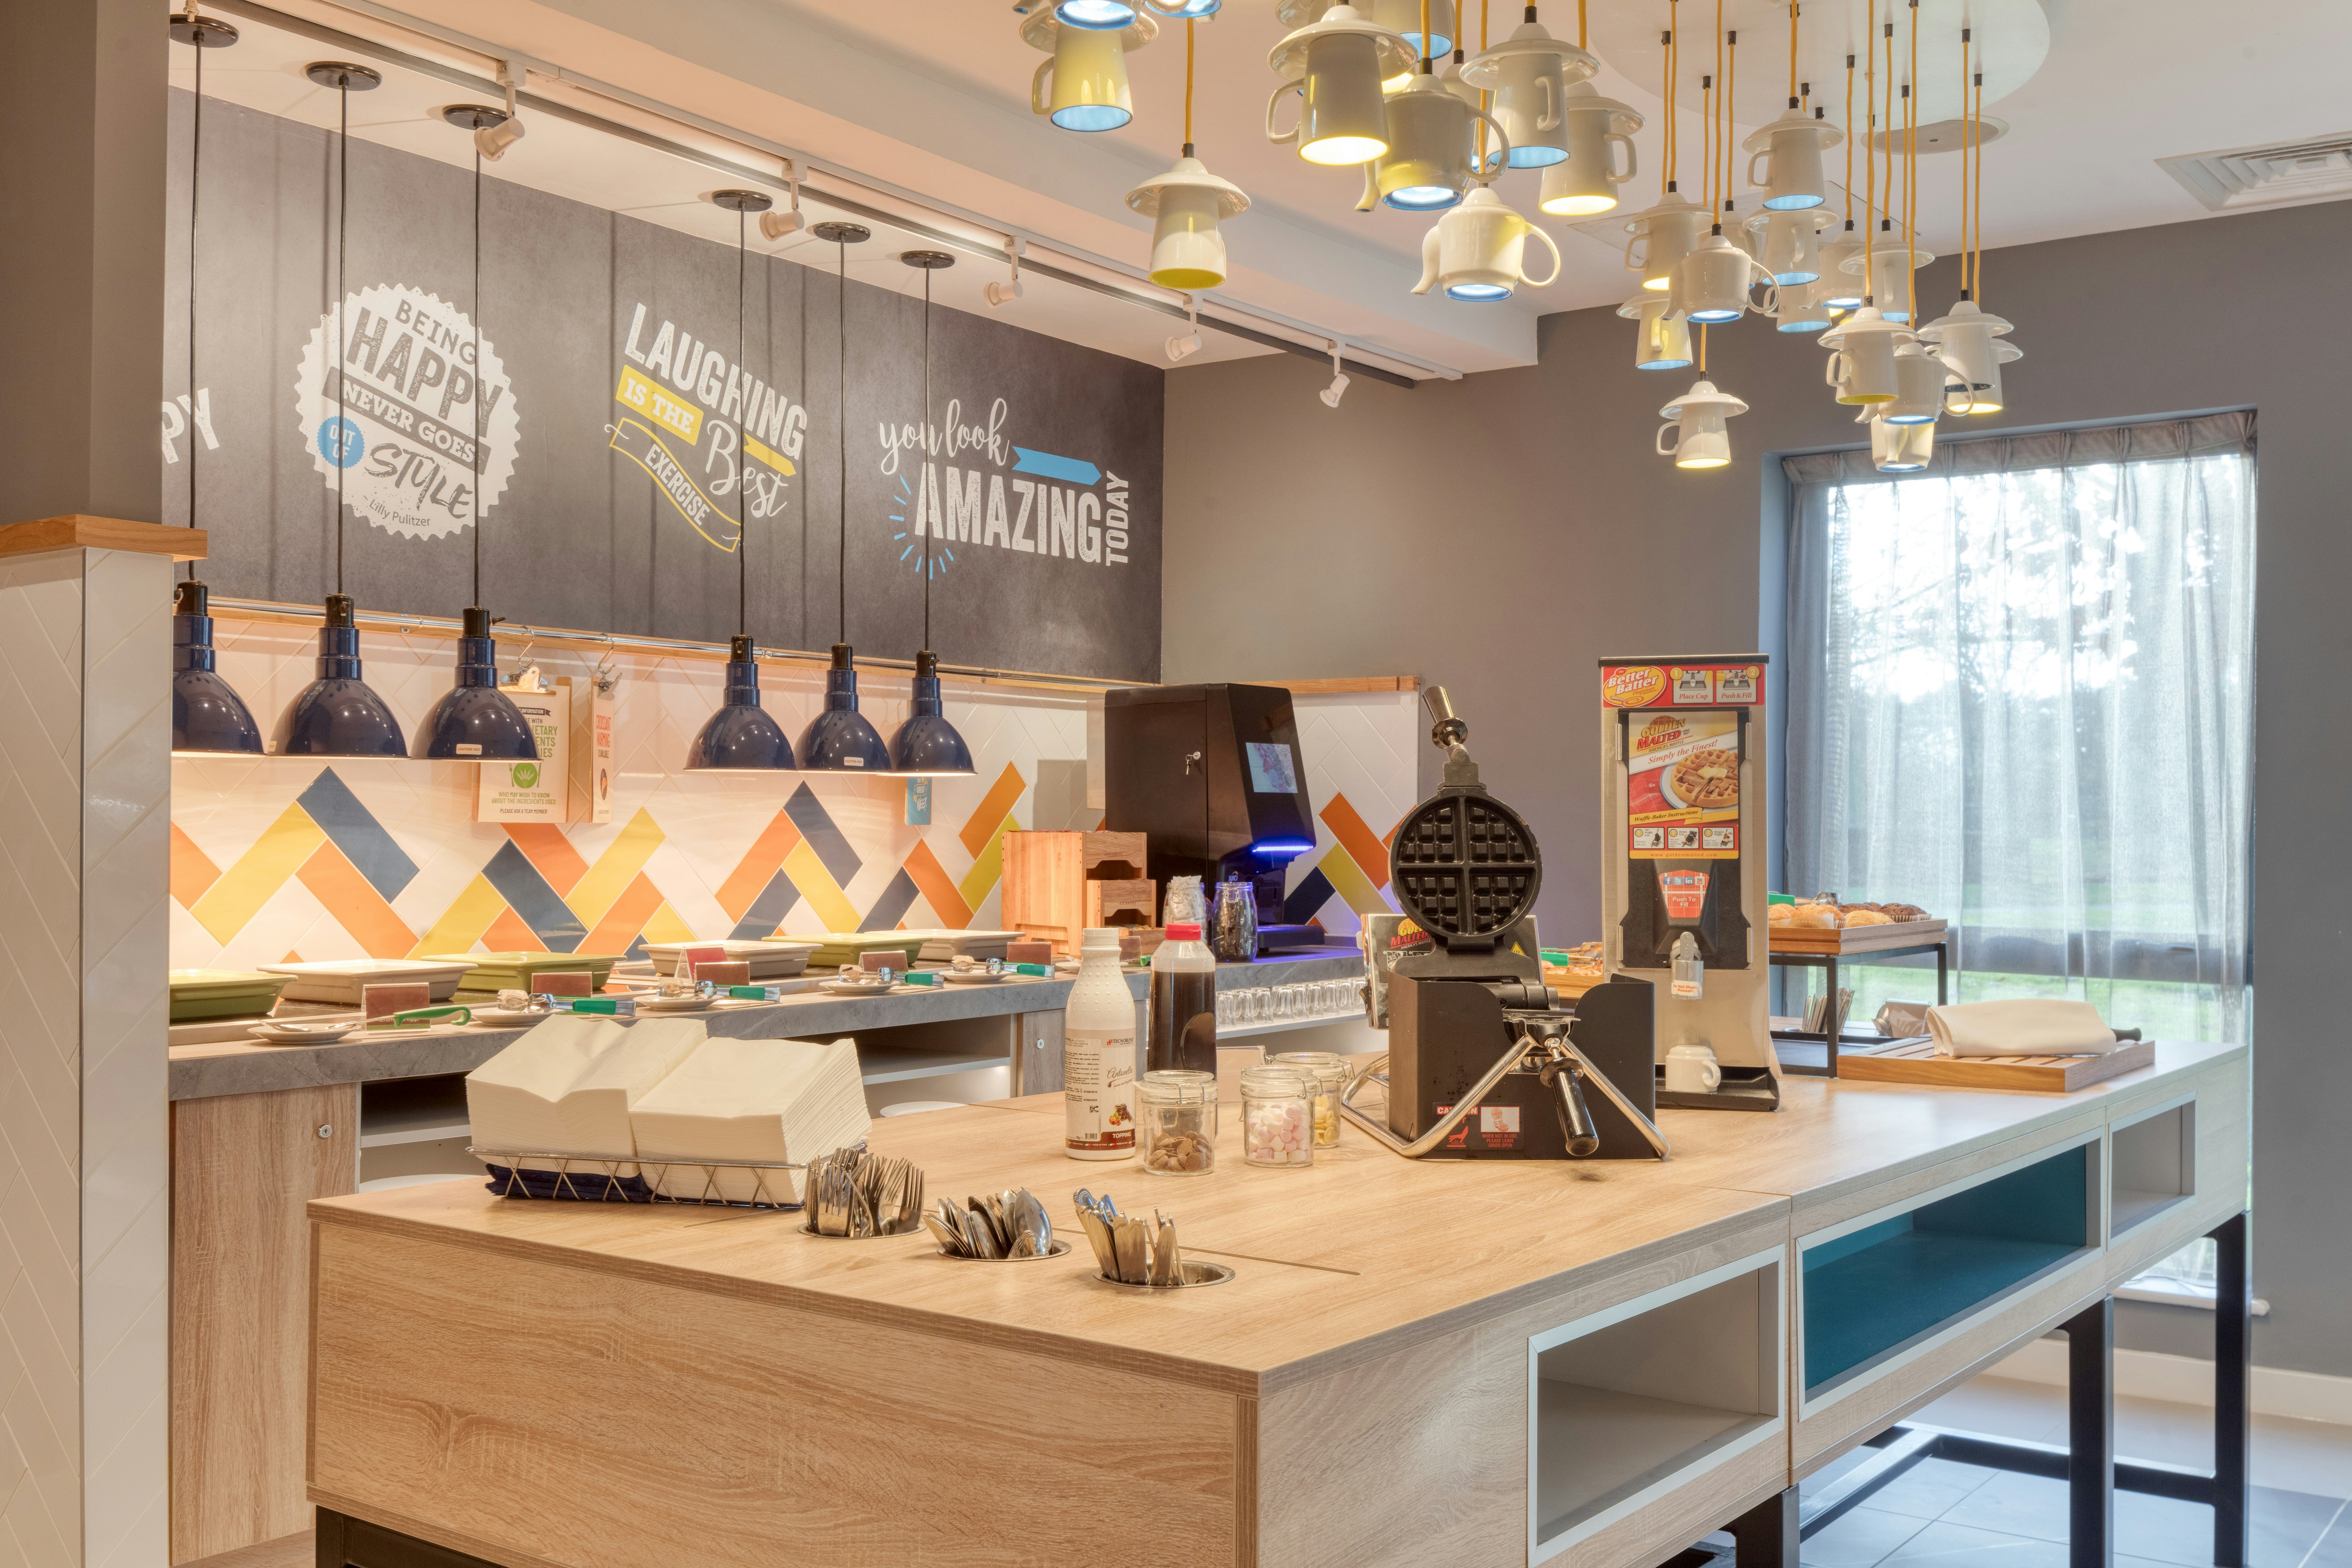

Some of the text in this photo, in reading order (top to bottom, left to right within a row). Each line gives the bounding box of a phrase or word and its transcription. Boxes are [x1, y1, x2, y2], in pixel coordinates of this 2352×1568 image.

[395, 298, 476, 365] BEING
[346, 306, 504, 438] HAPPY
[624, 302, 807, 460] LAUGHING
[624, 377, 694, 435] IS THE
[343, 379, 476, 462] NEVER GOES
[329, 424, 356, 446] OUT
[879, 397, 1010, 475] you look
[332, 443, 350, 460] OF
[364, 443, 473, 519] STYLE
[705, 419, 788, 518] Best
[644, 443, 711, 526] EXERCISE
[369, 499, 431, 526] Lilly Pulitzer
[914, 461, 1101, 563] AMAZING
[1105, 470, 1129, 566] TODAY
[1608, 668, 1651, 688] Better
[1615, 676, 1658, 695] Batter
[1633, 686, 1656, 695] Dispenser
[532, 725, 558, 735] IETARY
[1637, 730, 1682, 750] MALTED
[1641, 718, 1686, 738] GOLDEN
[1648, 739, 1718, 764] Simply the Finest!
[1649, 744, 1669, 753] AMERICA'S
[1390, 930, 1429, 946] MALTED
[1107, 1065, 1133, 1079] Antonella
